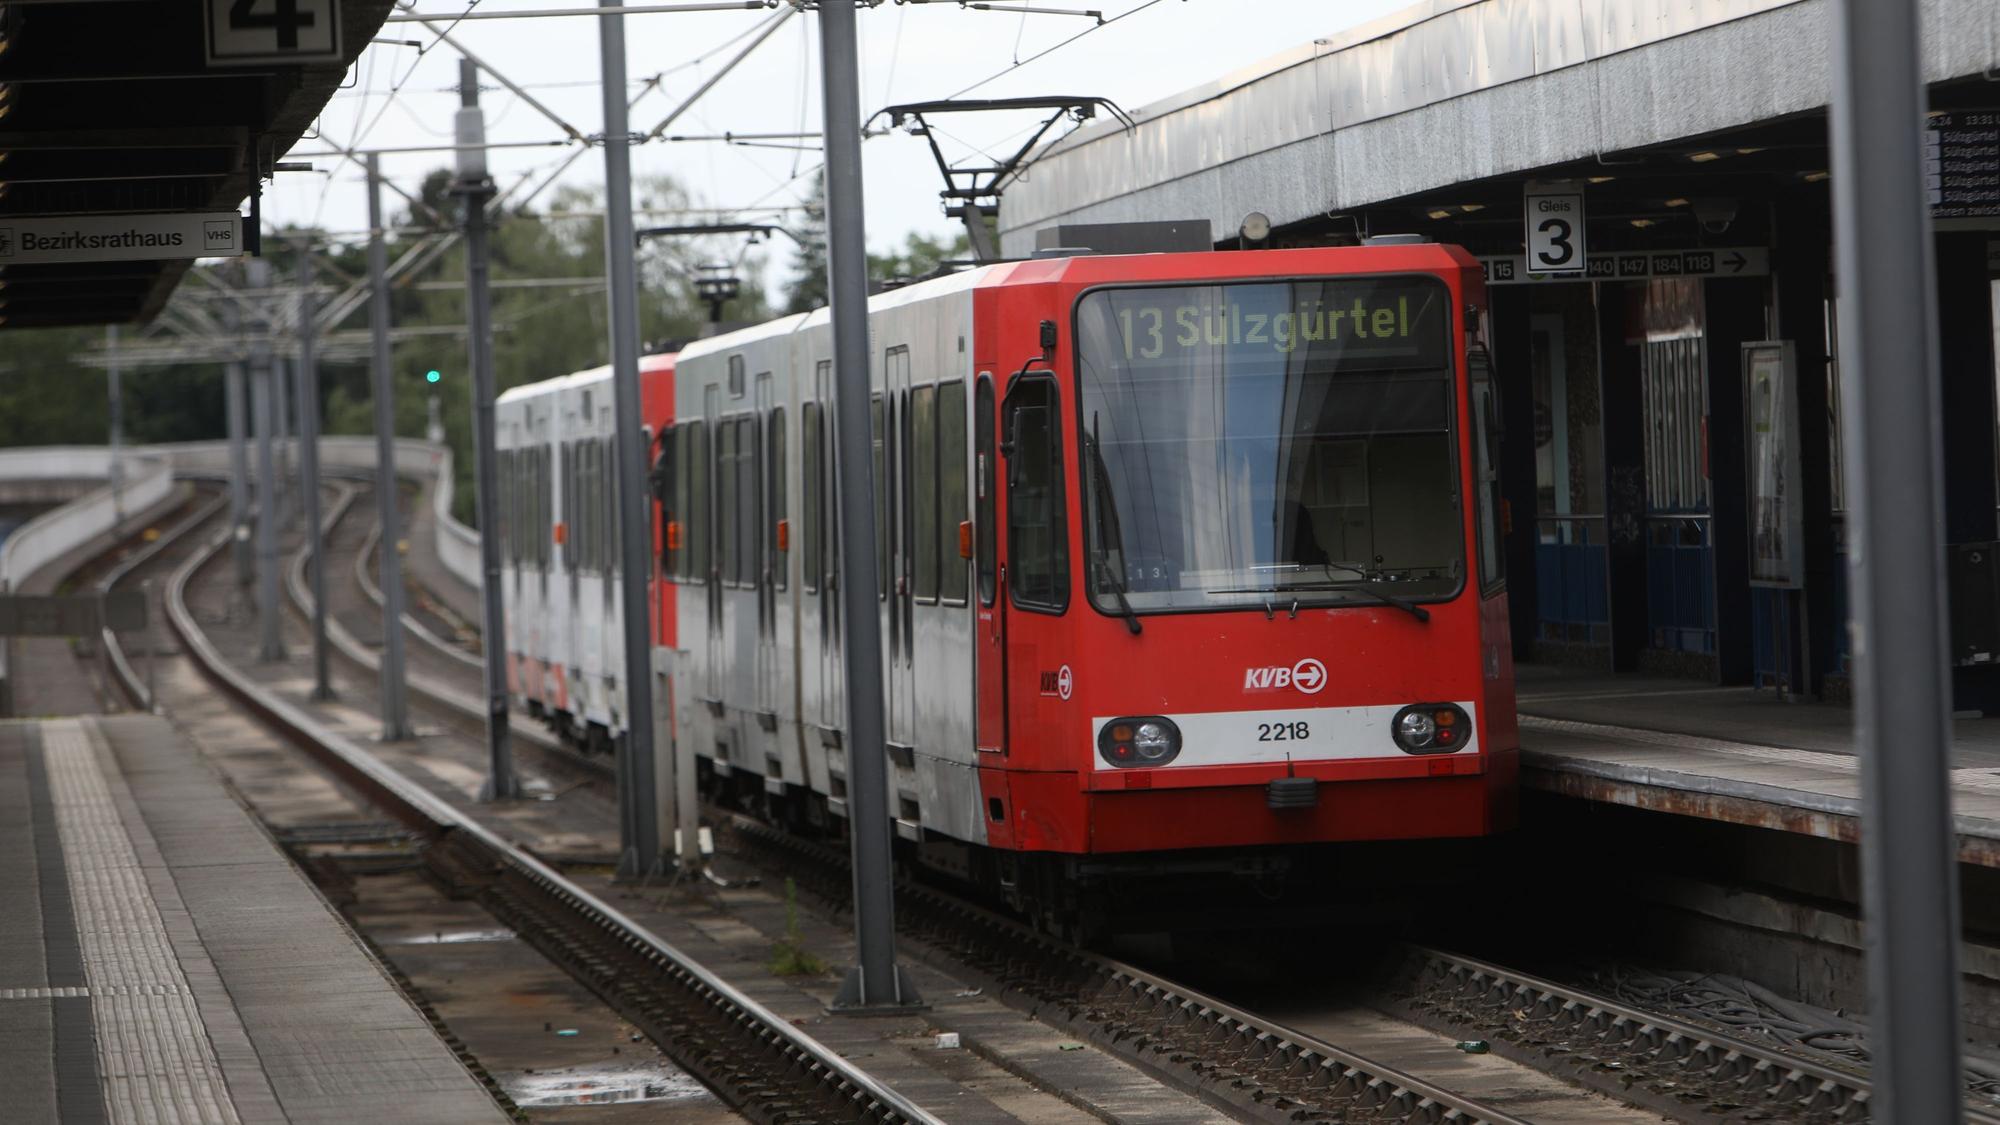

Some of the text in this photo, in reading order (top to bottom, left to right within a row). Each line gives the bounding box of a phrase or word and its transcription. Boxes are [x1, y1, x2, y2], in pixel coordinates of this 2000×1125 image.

[229, 0, 315, 48] 4
[1943, 131, 1998, 144] Sülzgürtel
[1943, 145, 1999, 158] Sülzgürtel
[1944, 160, 1999, 173] Sülzgürtel
[1538, 200, 1571, 213] Gleis
[21, 230, 231, 250] Bezirksrathaus VHS
[1538, 218, 1573, 265] 3
[1495, 263, 1512, 277] 15
[1588, 260, 1614, 274] 140
[1622, 259, 1645, 273] 147
[1654, 257, 1680, 271] 184
[1686, 255, 1711, 269] 118
[1120, 297, 1408, 359] 13 Sülzgürtel
[1245, 667, 1291, 688] KVB
[1258, 721, 1309, 741] 2218
